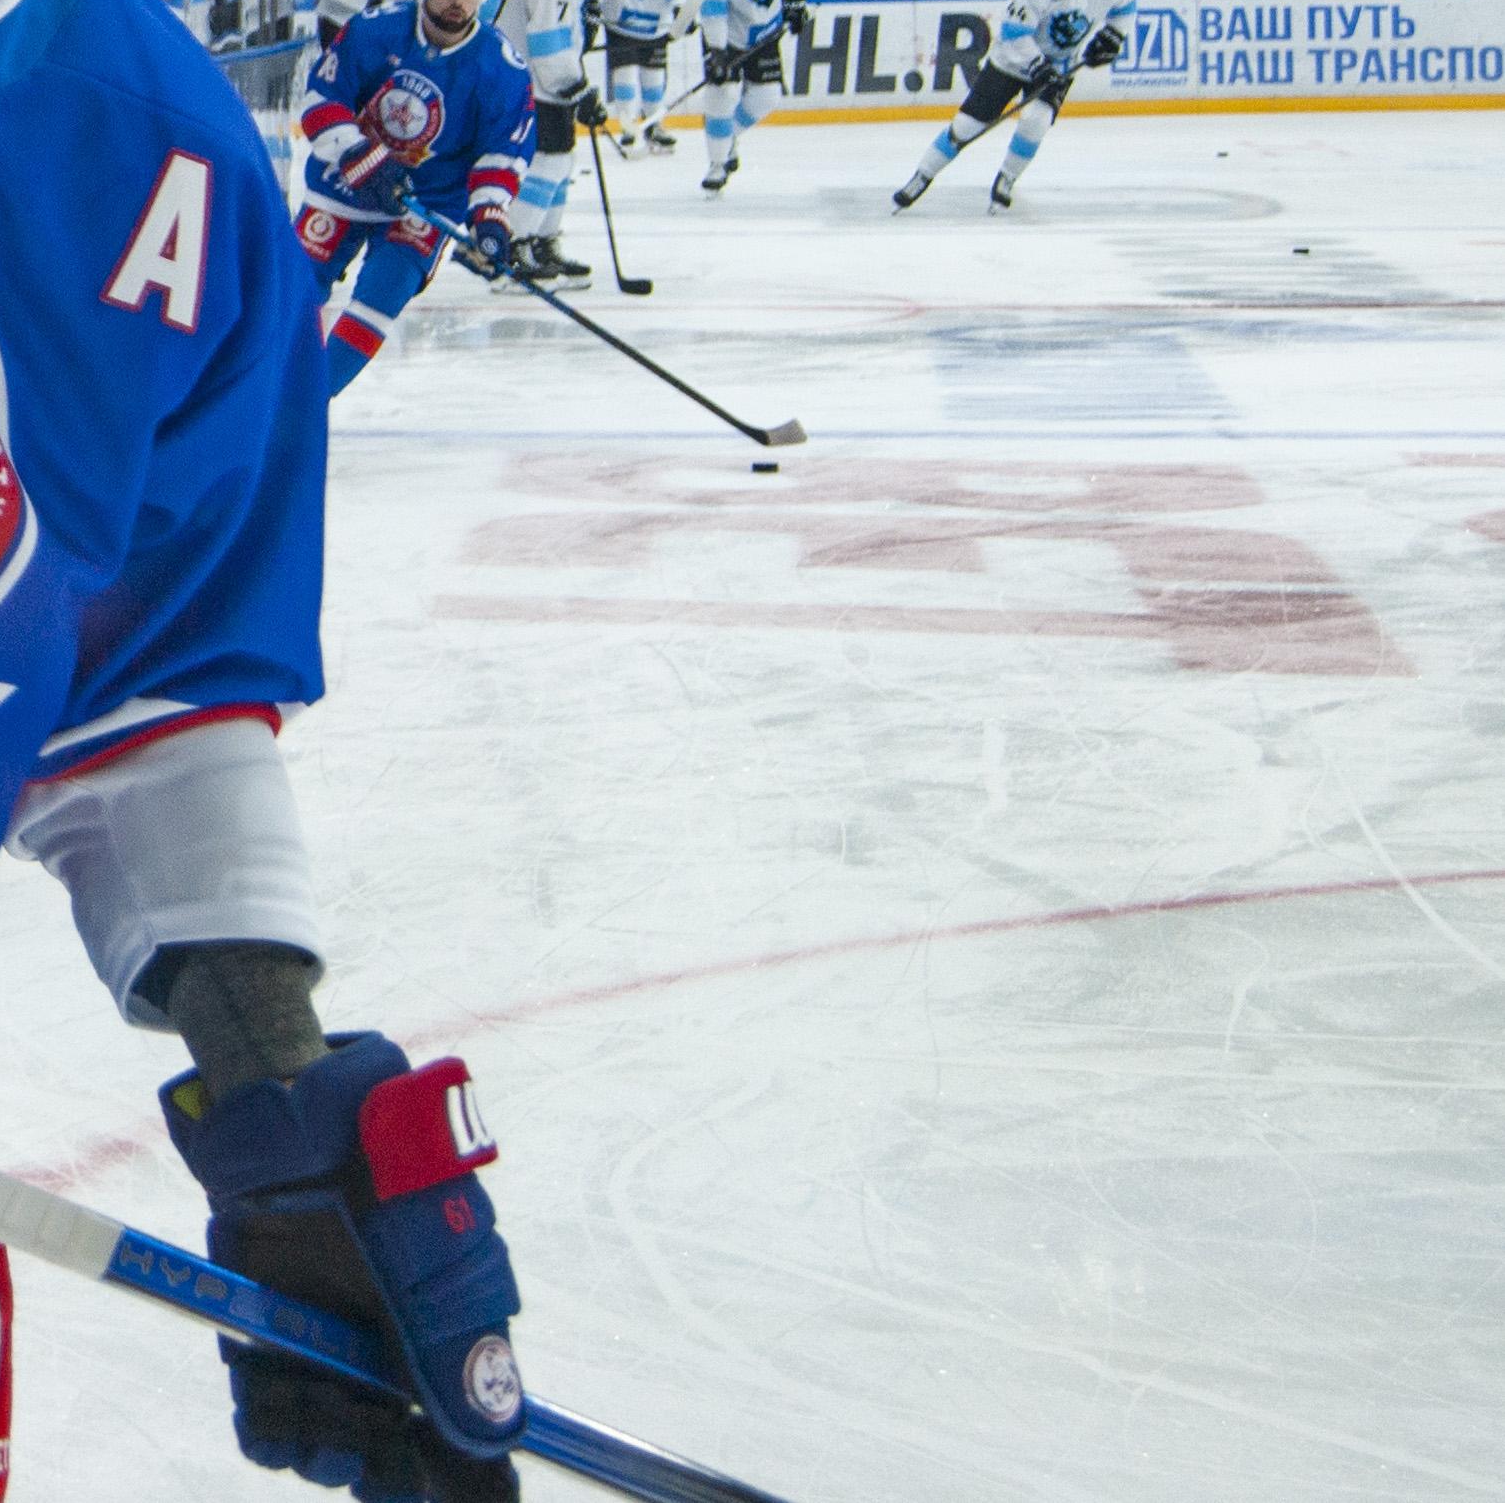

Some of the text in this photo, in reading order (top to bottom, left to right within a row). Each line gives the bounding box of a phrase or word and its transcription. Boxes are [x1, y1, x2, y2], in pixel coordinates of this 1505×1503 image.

[1200, 4, 1415, 41] ВАШ ПУТЬ
[793, 14, 991, 95] HL.R
[1200, 46, 1504, 85] НАШ ТРАНСПО
[99, 147, 214, 335] A
